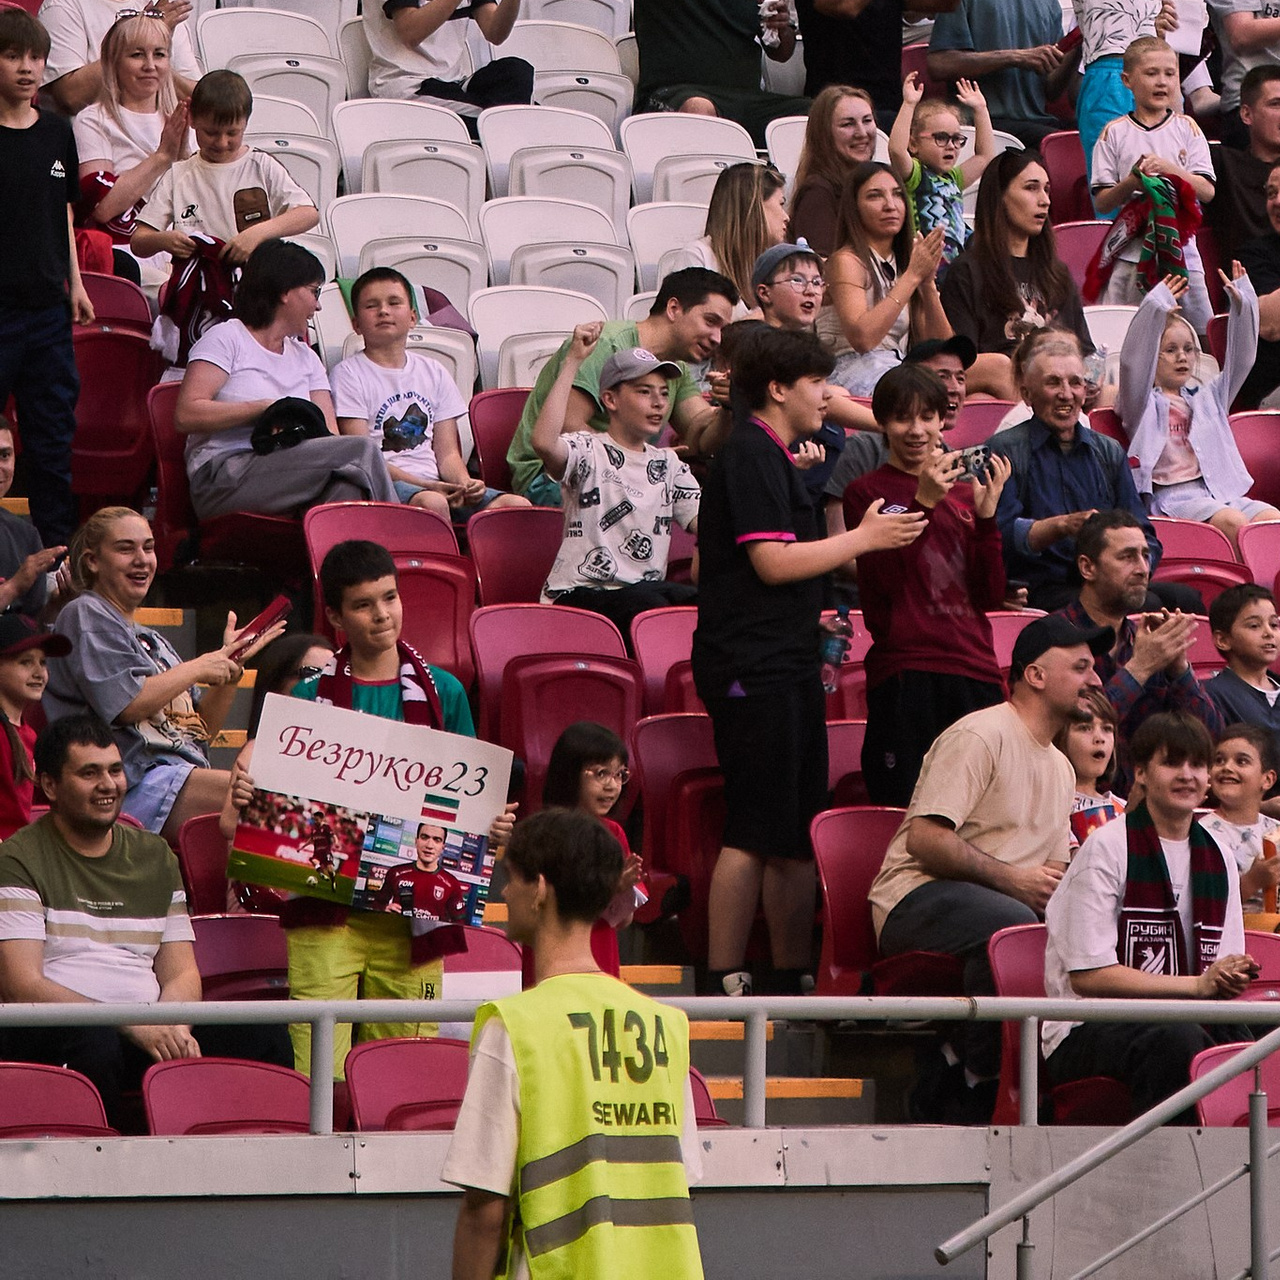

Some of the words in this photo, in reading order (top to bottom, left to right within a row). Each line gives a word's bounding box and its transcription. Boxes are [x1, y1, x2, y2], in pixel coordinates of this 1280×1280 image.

[374, 403, 389, 431] BATUR
[279, 723, 488, 798] Безруков23
[1130, 924, 1173, 936] РУБИН
[568, 1009, 670, 1084] 7434
